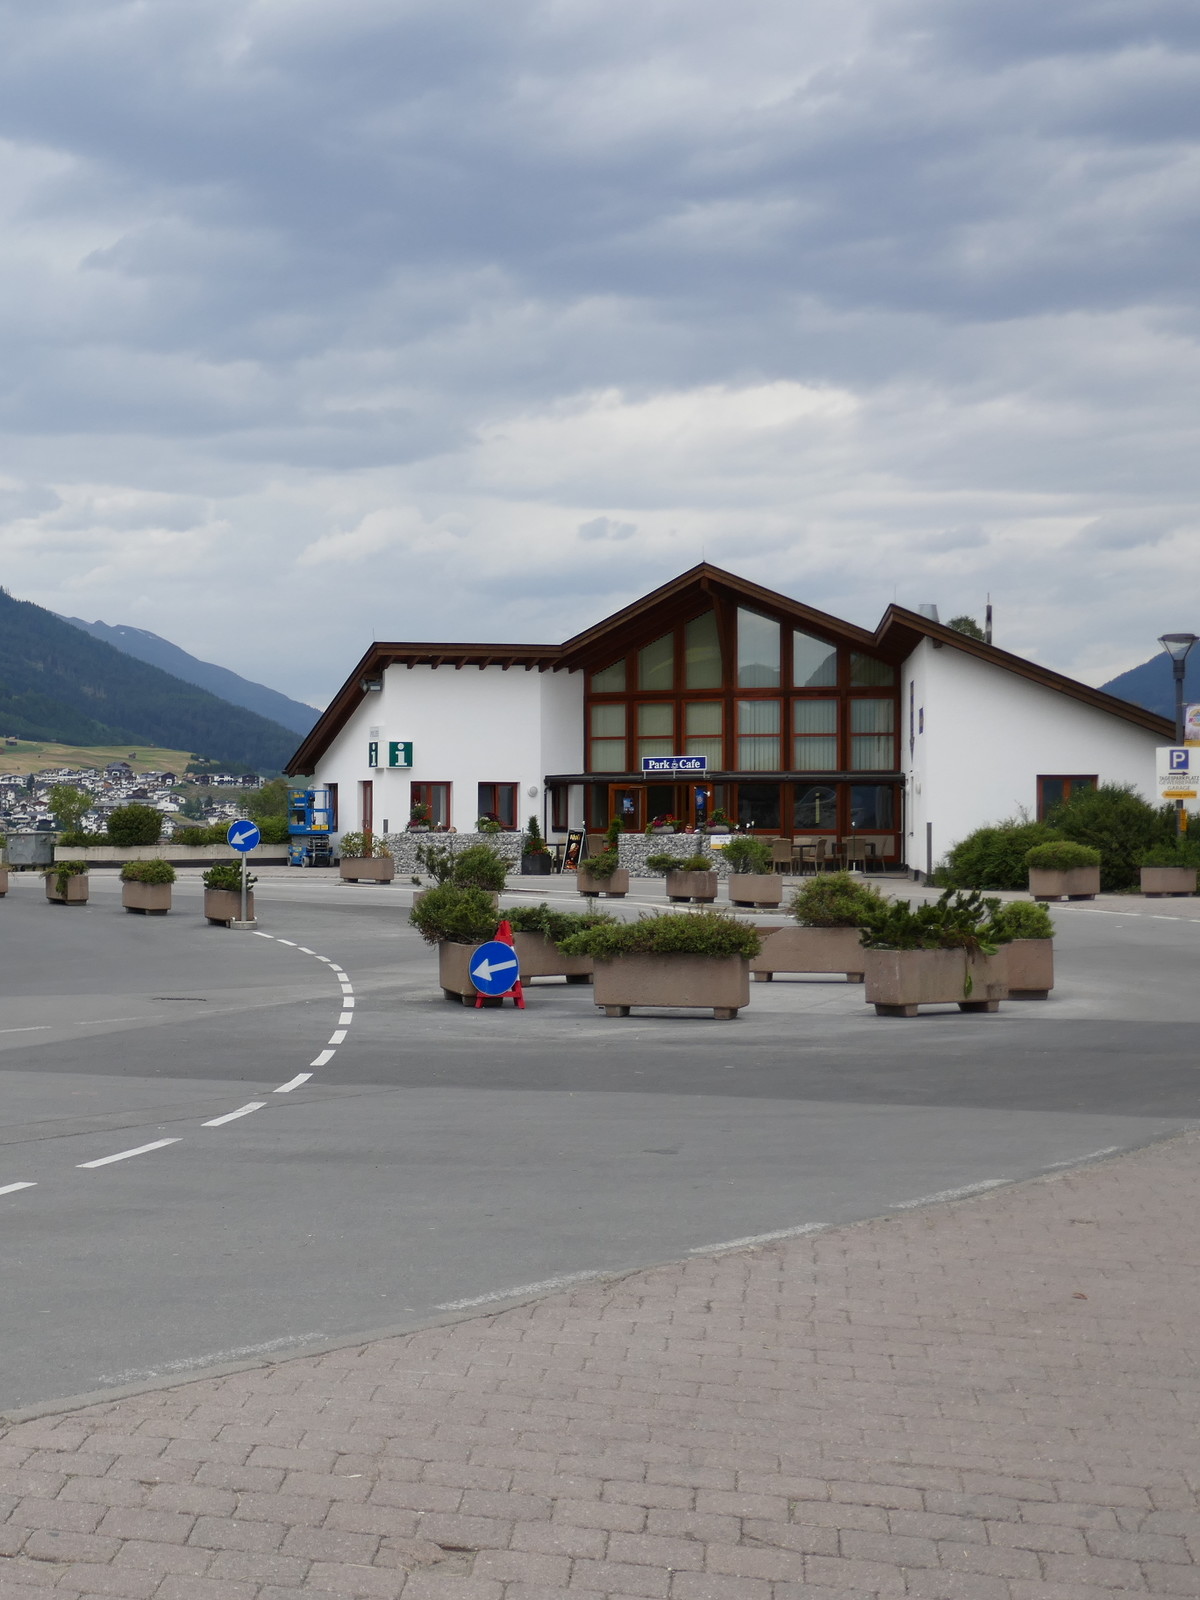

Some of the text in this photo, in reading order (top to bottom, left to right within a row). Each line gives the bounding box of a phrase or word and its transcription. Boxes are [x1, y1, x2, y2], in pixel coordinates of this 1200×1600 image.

[648, 759, 701, 769] Park Cafe
[1172, 751, 1186, 768] P
